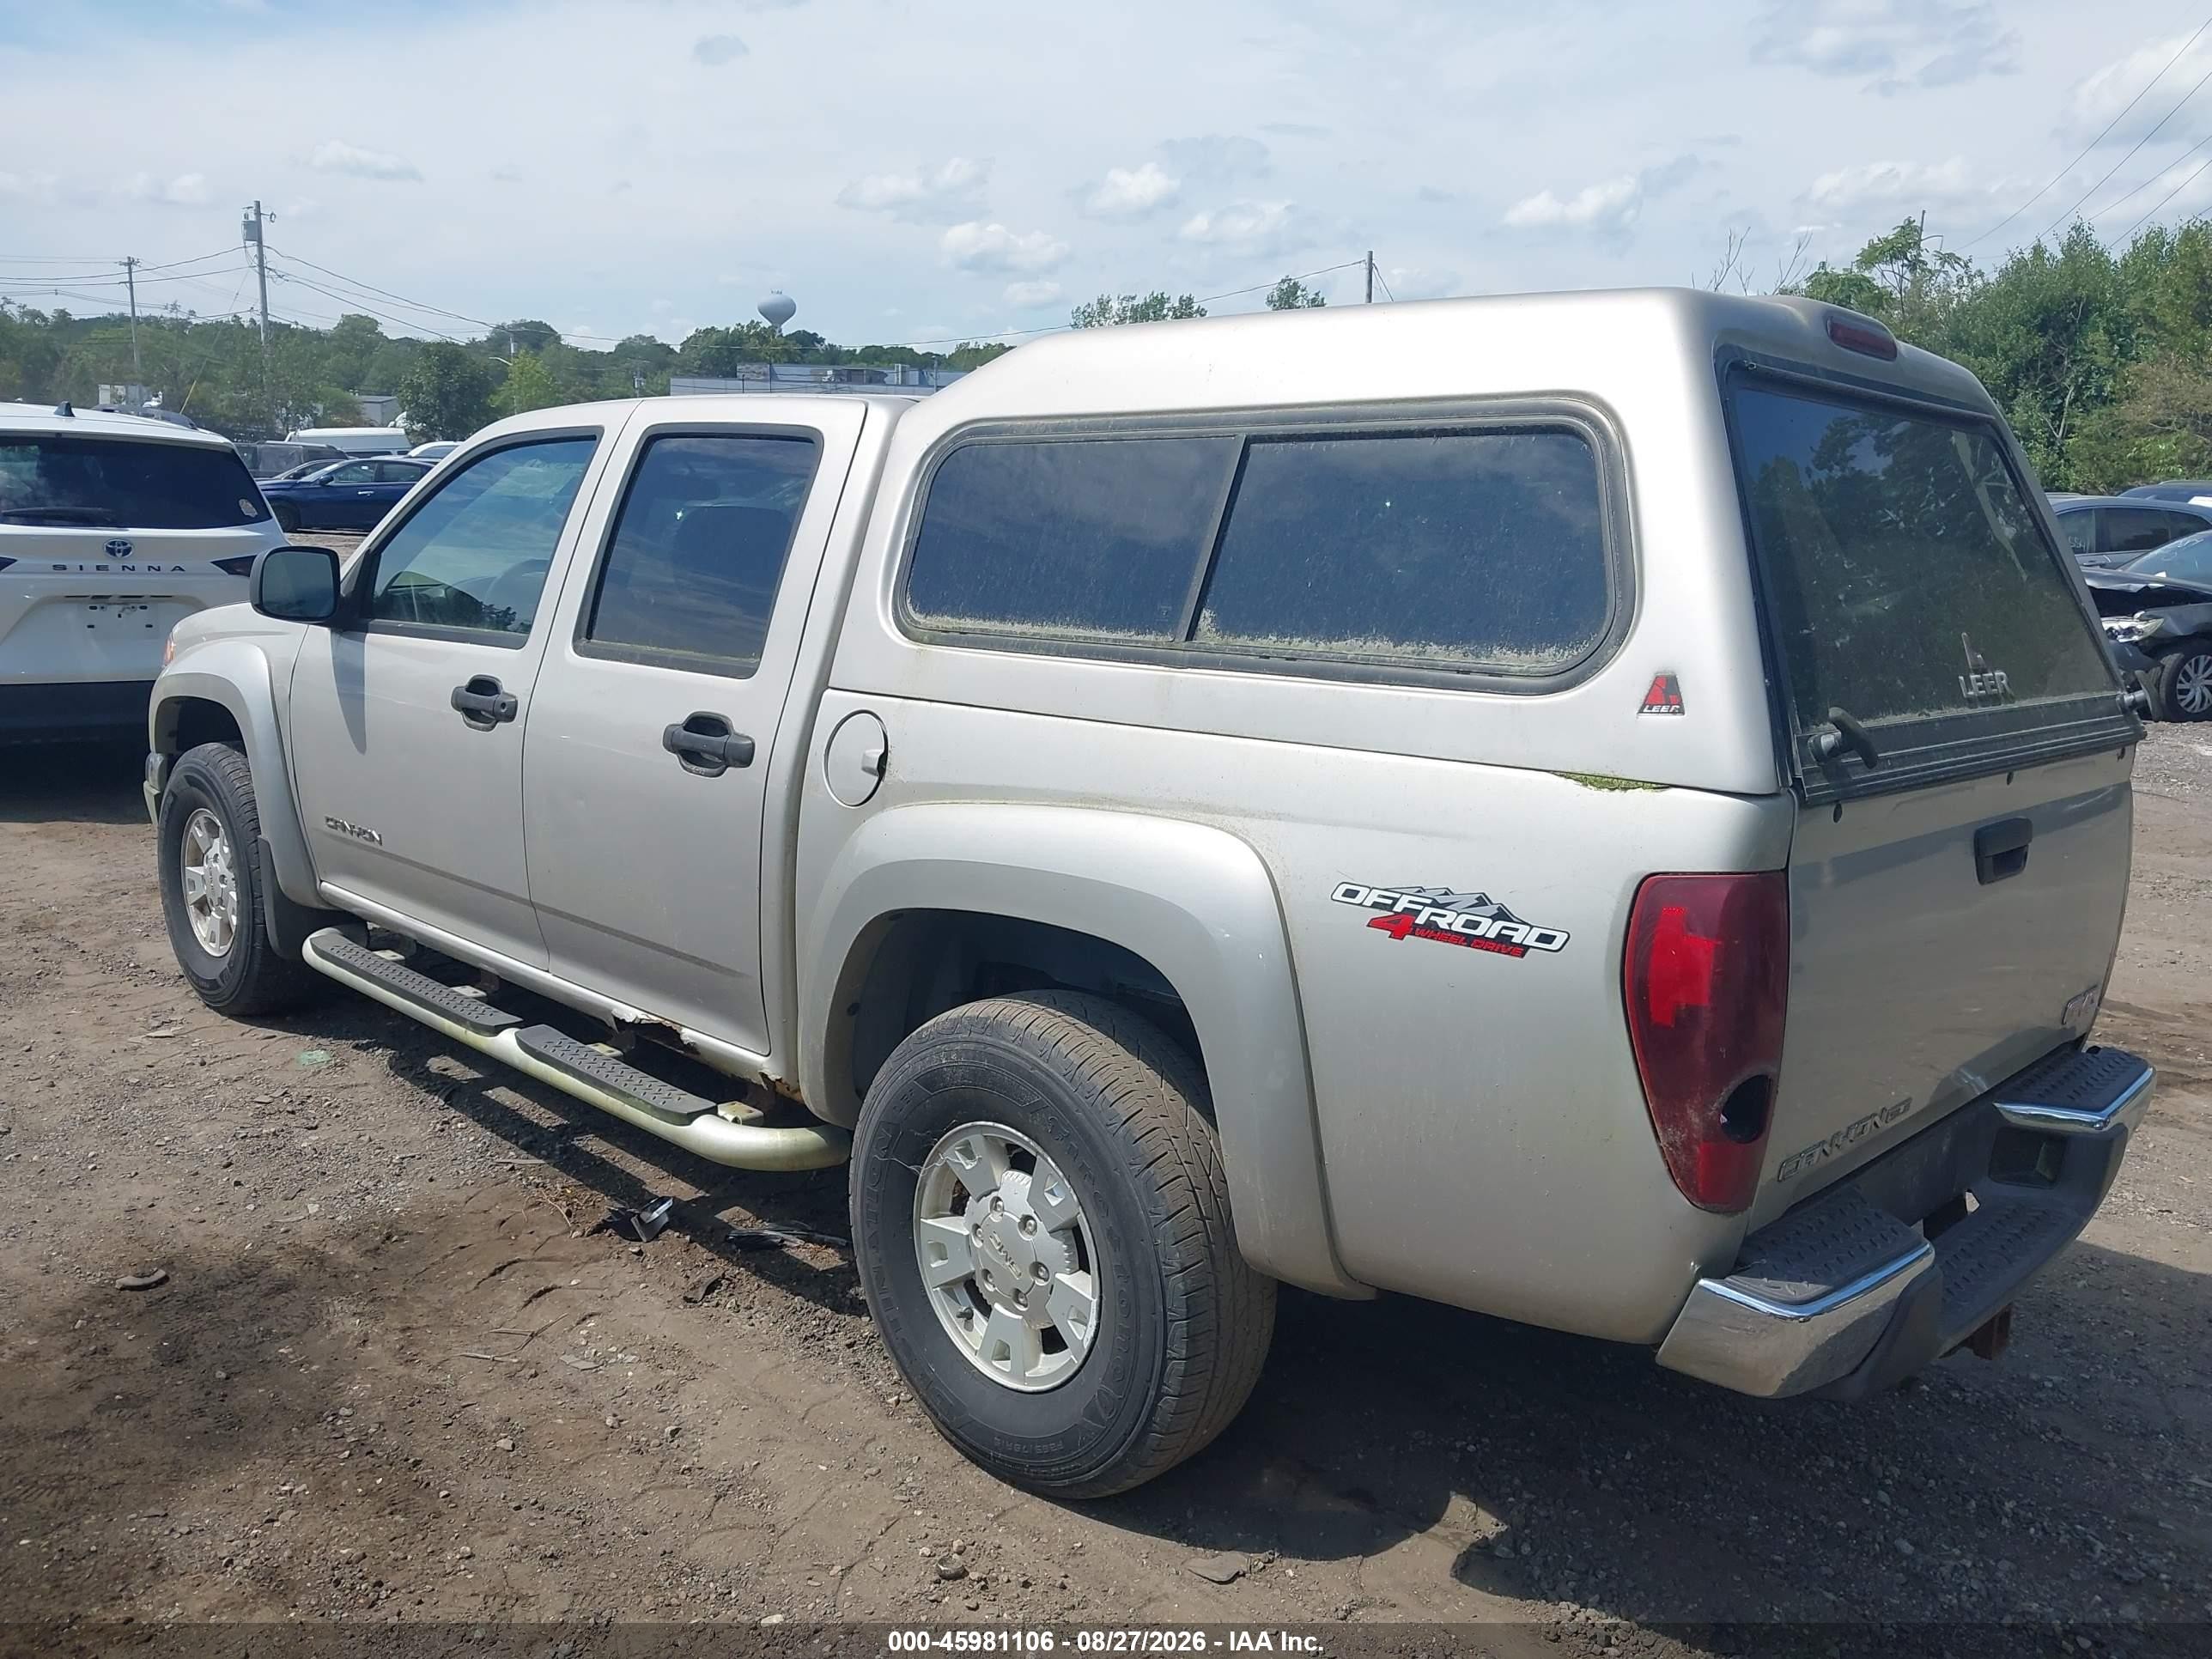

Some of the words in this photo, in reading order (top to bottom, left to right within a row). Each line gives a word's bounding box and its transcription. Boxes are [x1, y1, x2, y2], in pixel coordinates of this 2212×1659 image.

[1958, 672, 2015, 699] LEER
[1642, 704, 1680, 714] LEER
[1368, 914, 1415, 940] 4
[1413, 927, 1468, 945] WHEEL
[1469, 938, 1525, 957] DRIVE
[988, 1230, 1023, 1280] GMC
